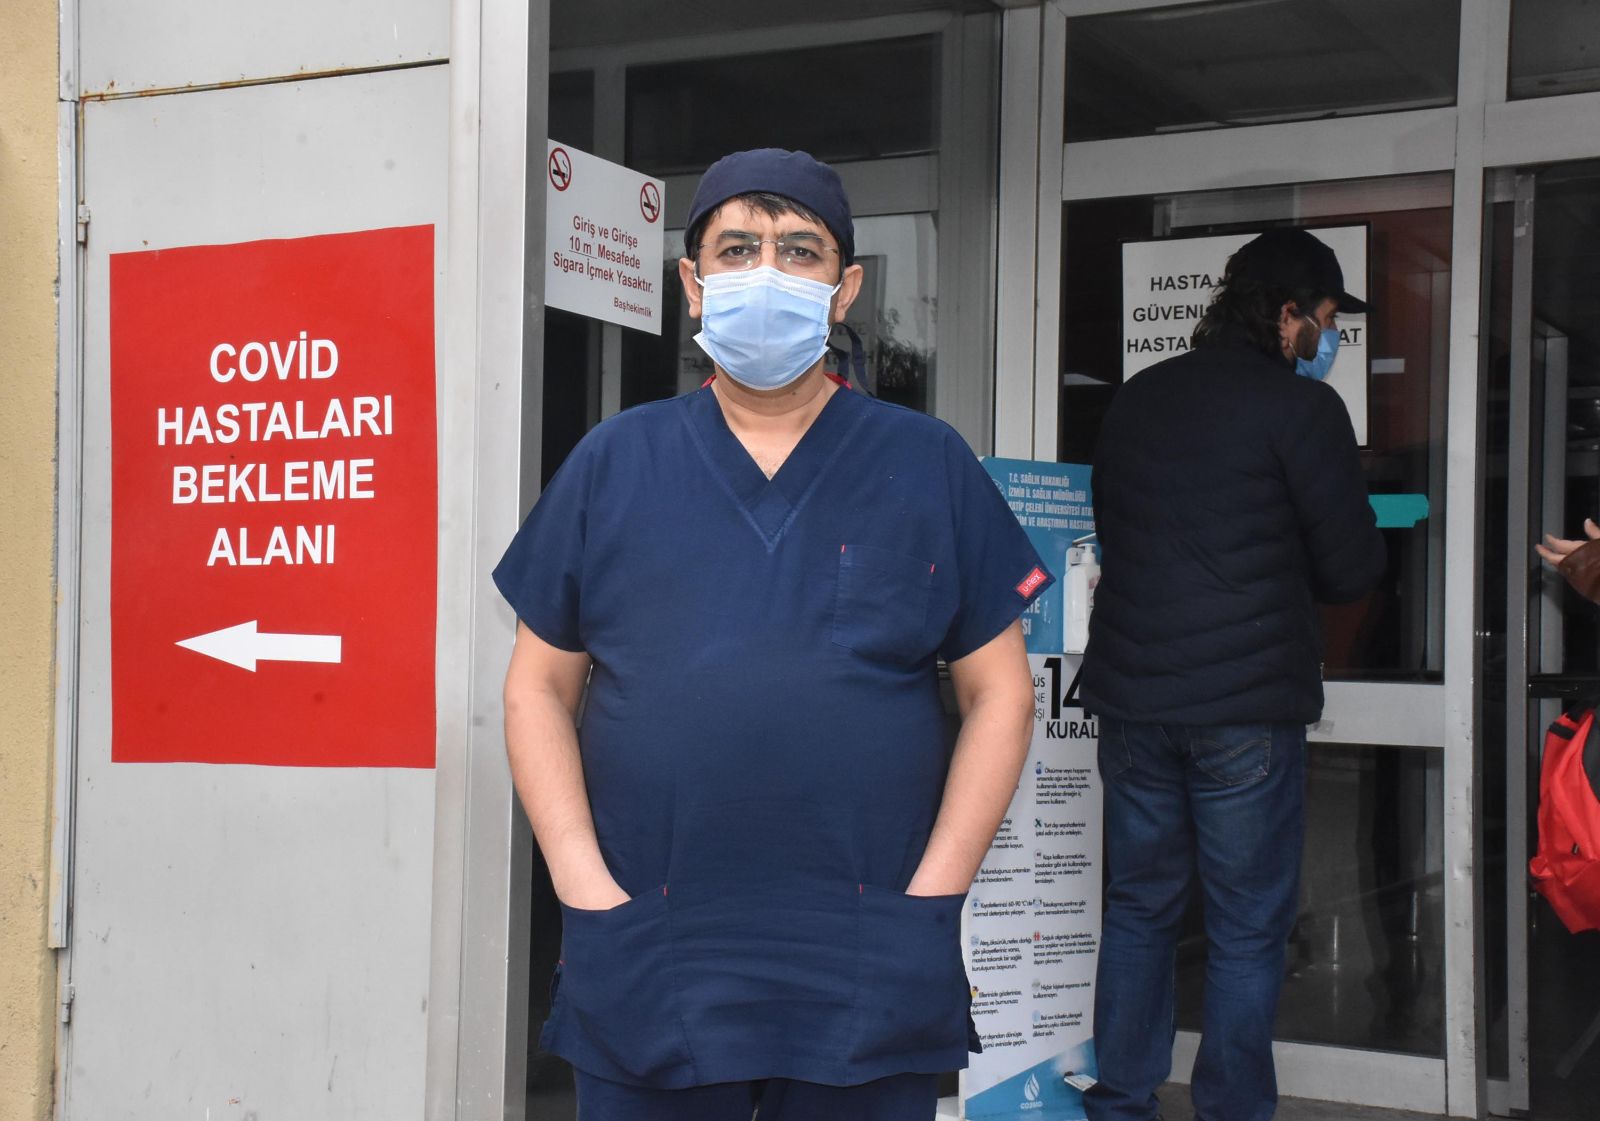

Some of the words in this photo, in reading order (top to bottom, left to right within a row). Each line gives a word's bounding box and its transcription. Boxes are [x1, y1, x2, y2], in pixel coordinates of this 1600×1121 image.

[573, 215, 595, 237] Giriş
[598, 226, 608, 238] ve
[612, 228, 637, 249] Girişe
[569, 236, 580, 251] 10
[583, 242, 591, 254] m
[598, 244, 640, 269] Mesafede
[553, 252, 583, 273] Sigara
[587, 259, 614, 281] İçmek
[617, 270, 653, 293] Yasaktır.
[1151, 274, 1212, 291] HASTA
[614, 297, 652, 317] Başhekimlik
[1339, 328, 1361, 344] AT
[210, 331, 338, 383] COVİD
[158, 395, 392, 445] HASTALARI
[173, 459, 374, 504] BEKLEME
[1009, 473, 1018, 483] T.C.
[1020, 473, 1040, 484] SAĞLIK
[1041, 475, 1069, 487] BAKANLIĞI
[1009, 485, 1024, 497] İZMİR
[1026, 487, 1031, 498] İL
[1033, 488, 1051, 499] SAĞLIK
[1029, 516, 1035, 526] VE
[207, 525, 334, 566] ALANI
[1044, 657, 1091, 719] 14
[1047, 722, 1098, 738] KURAL
